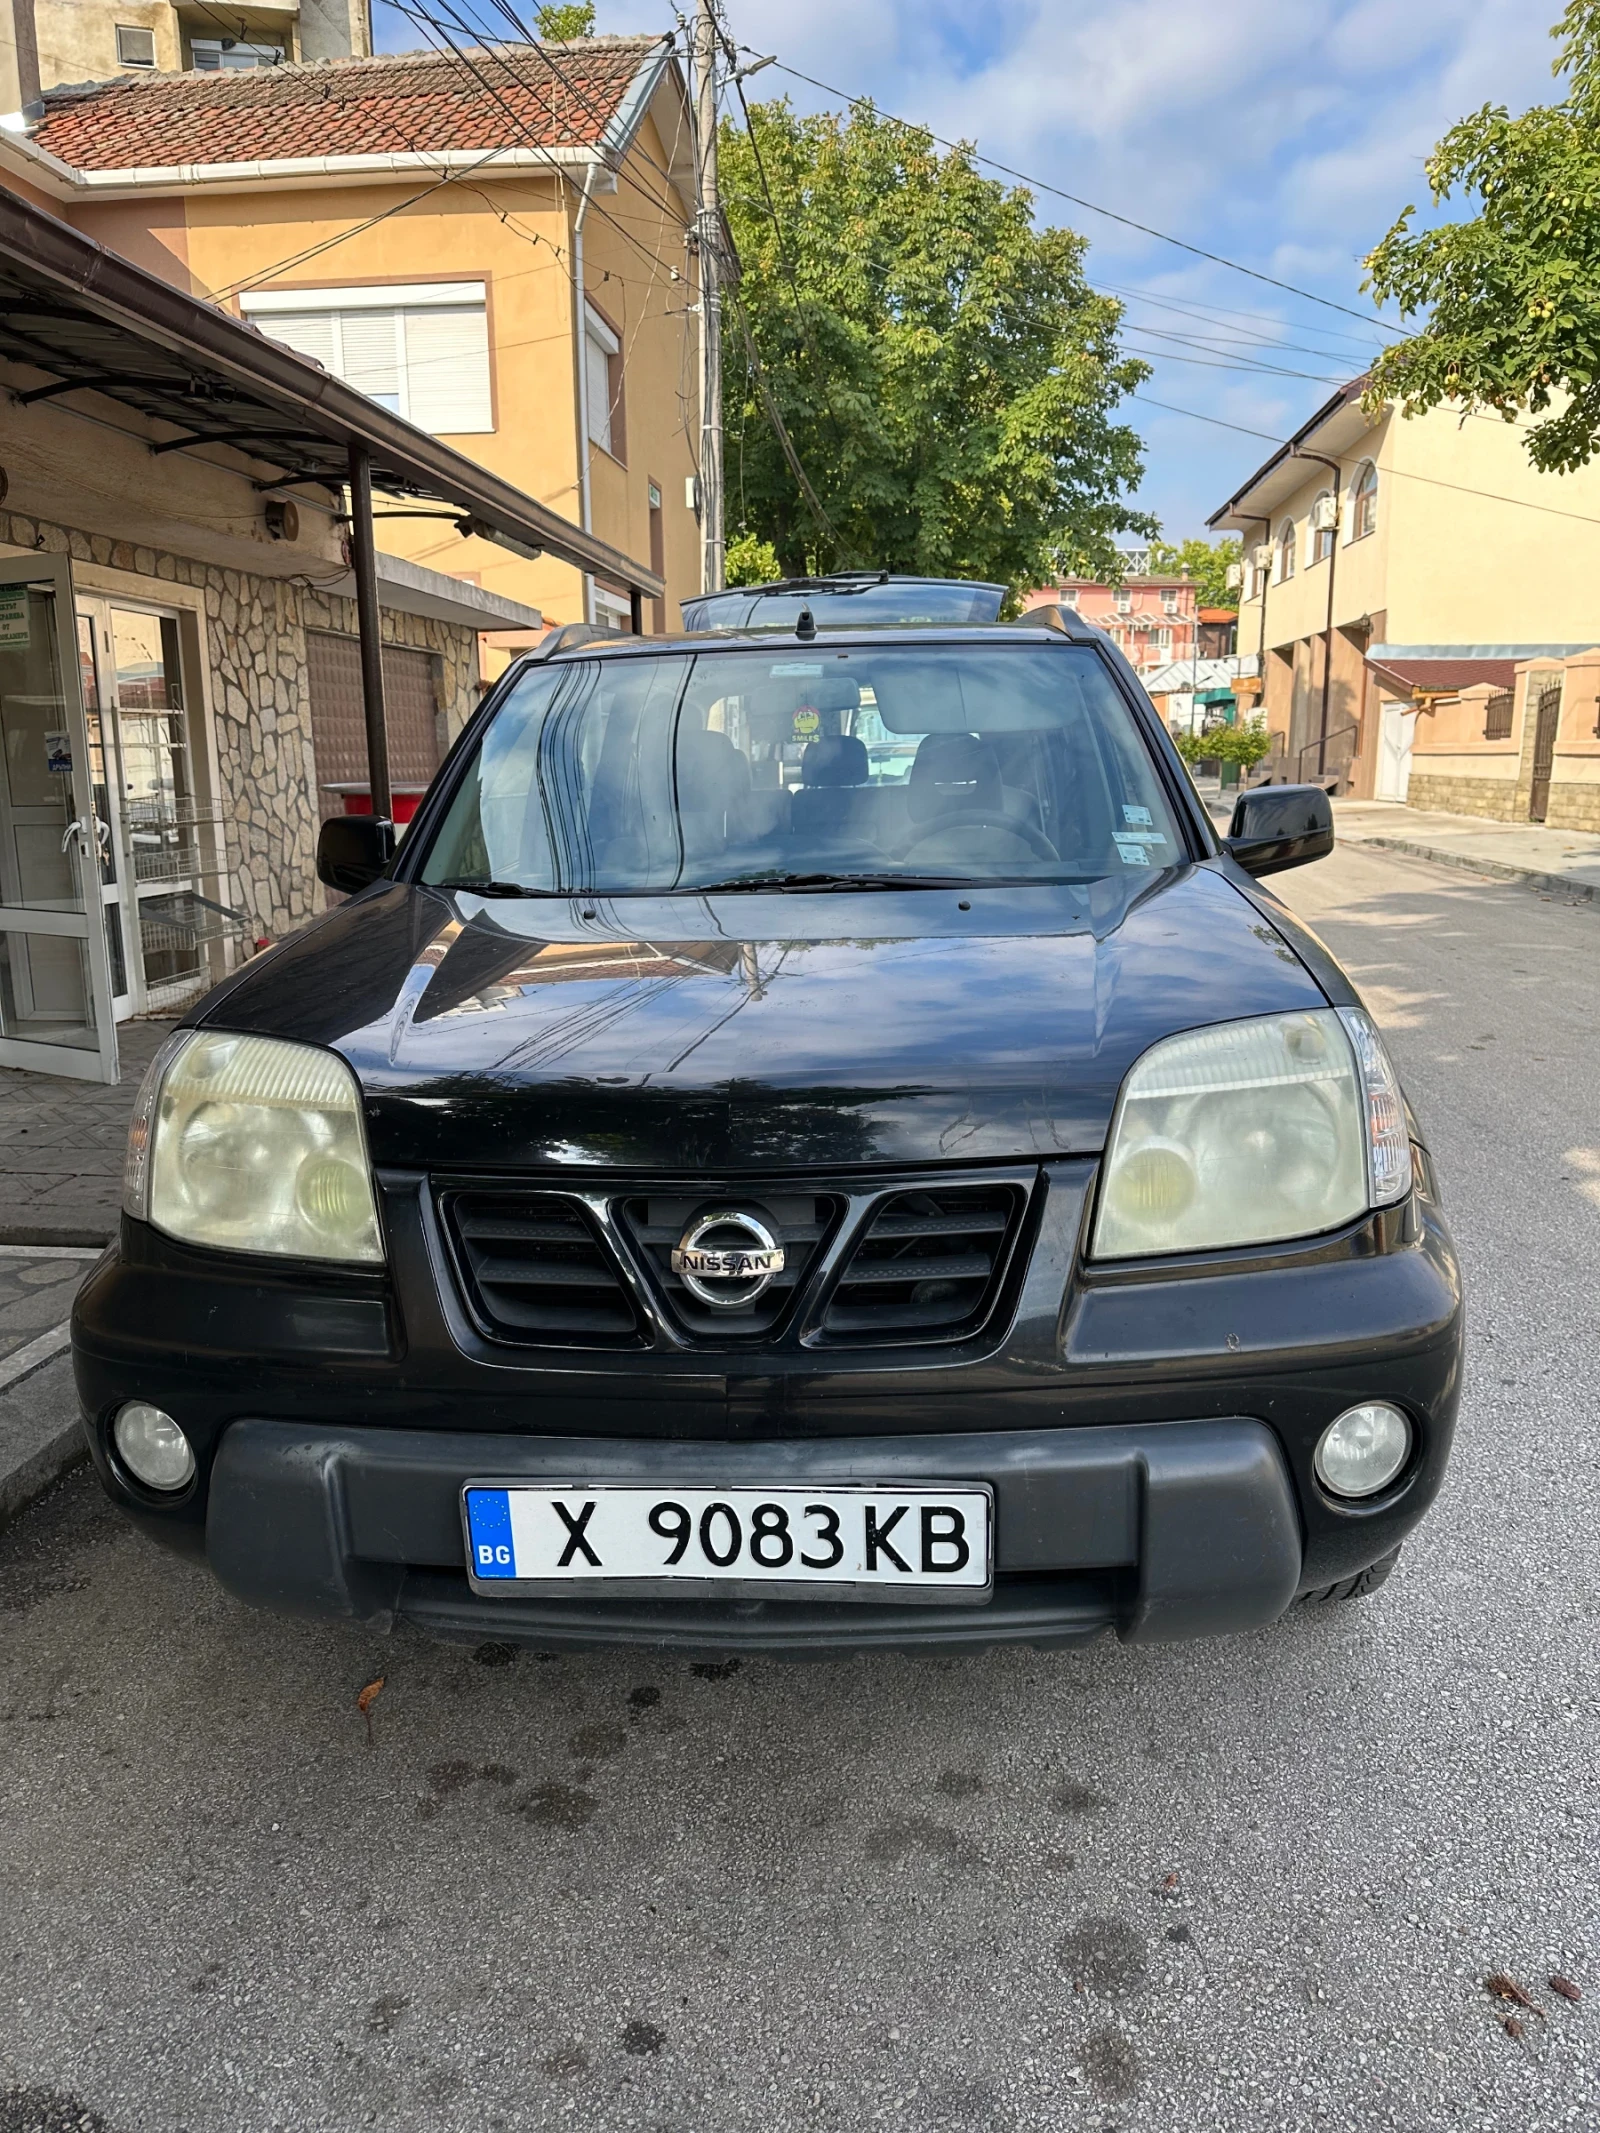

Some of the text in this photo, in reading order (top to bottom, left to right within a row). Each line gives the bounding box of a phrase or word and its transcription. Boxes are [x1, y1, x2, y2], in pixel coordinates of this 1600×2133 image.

[791, 734, 820, 743] SMILES
[682, 1255, 771, 1272] NISSAN
[648, 1501, 845, 1569] 9083
[478, 1545, 511, 1566] BG
